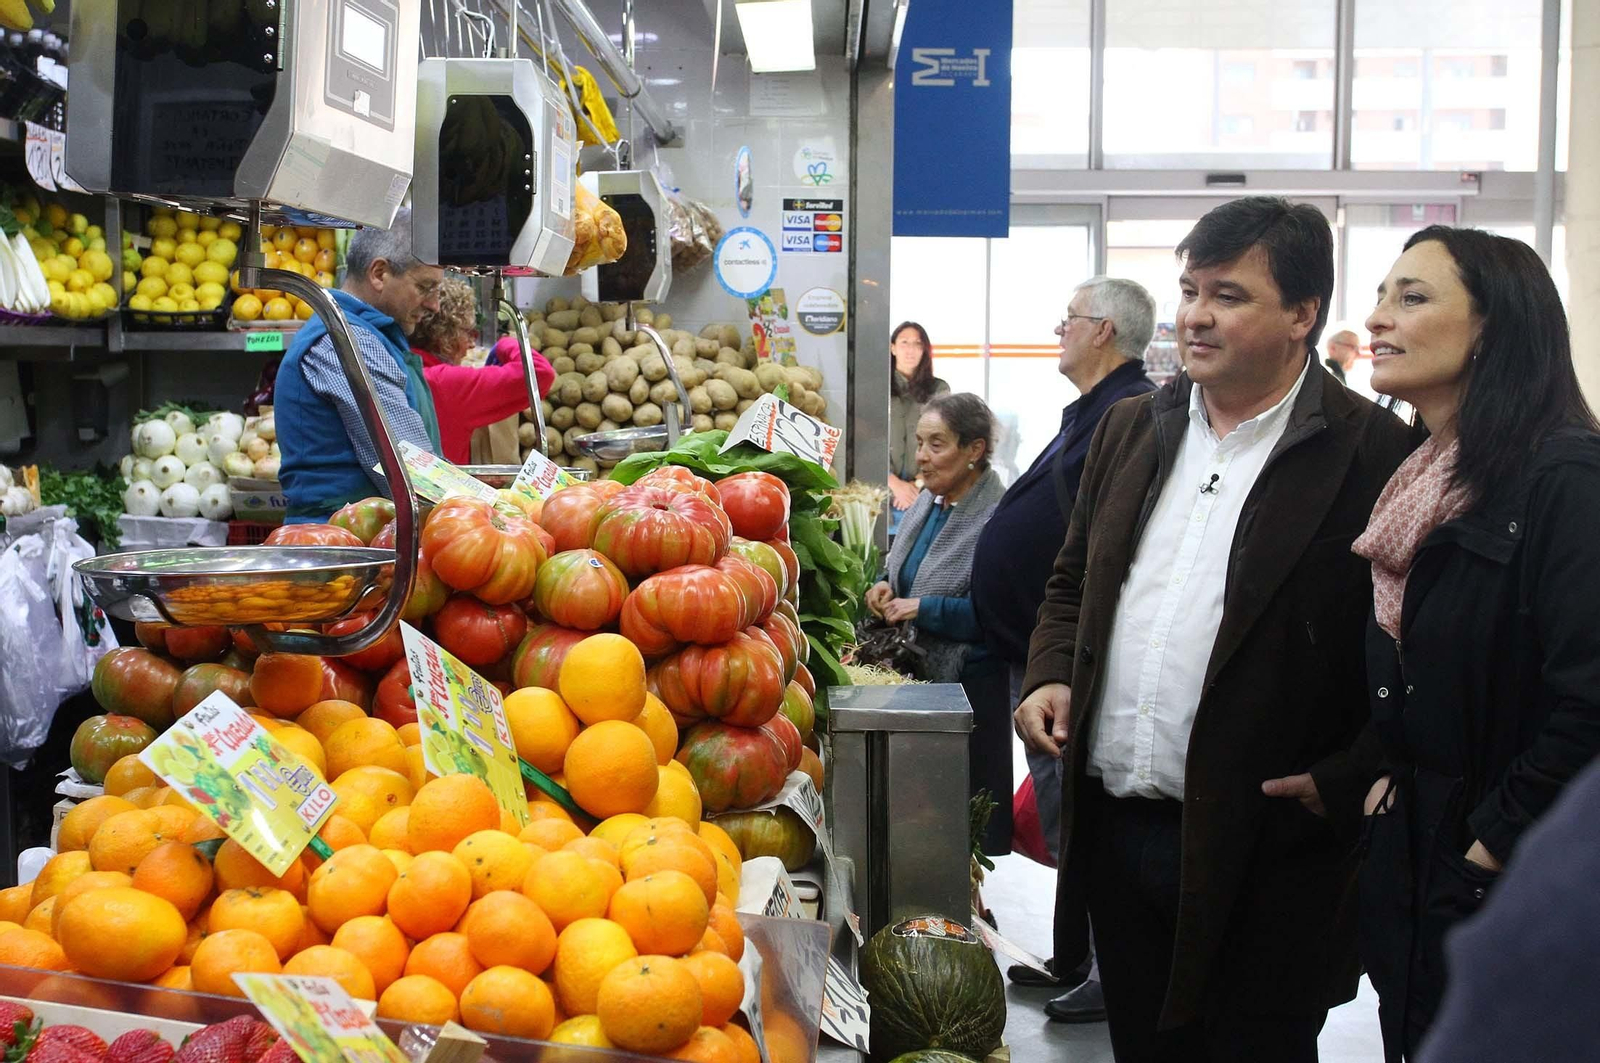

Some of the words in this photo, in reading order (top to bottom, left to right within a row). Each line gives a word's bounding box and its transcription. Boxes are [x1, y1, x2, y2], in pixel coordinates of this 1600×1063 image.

[786, 215, 811, 224] VISA
[786, 235, 810, 245] VISA
[724, 258, 760, 266] contactless
[489, 689, 510, 744] KILO
[300, 788, 332, 823] KILO
